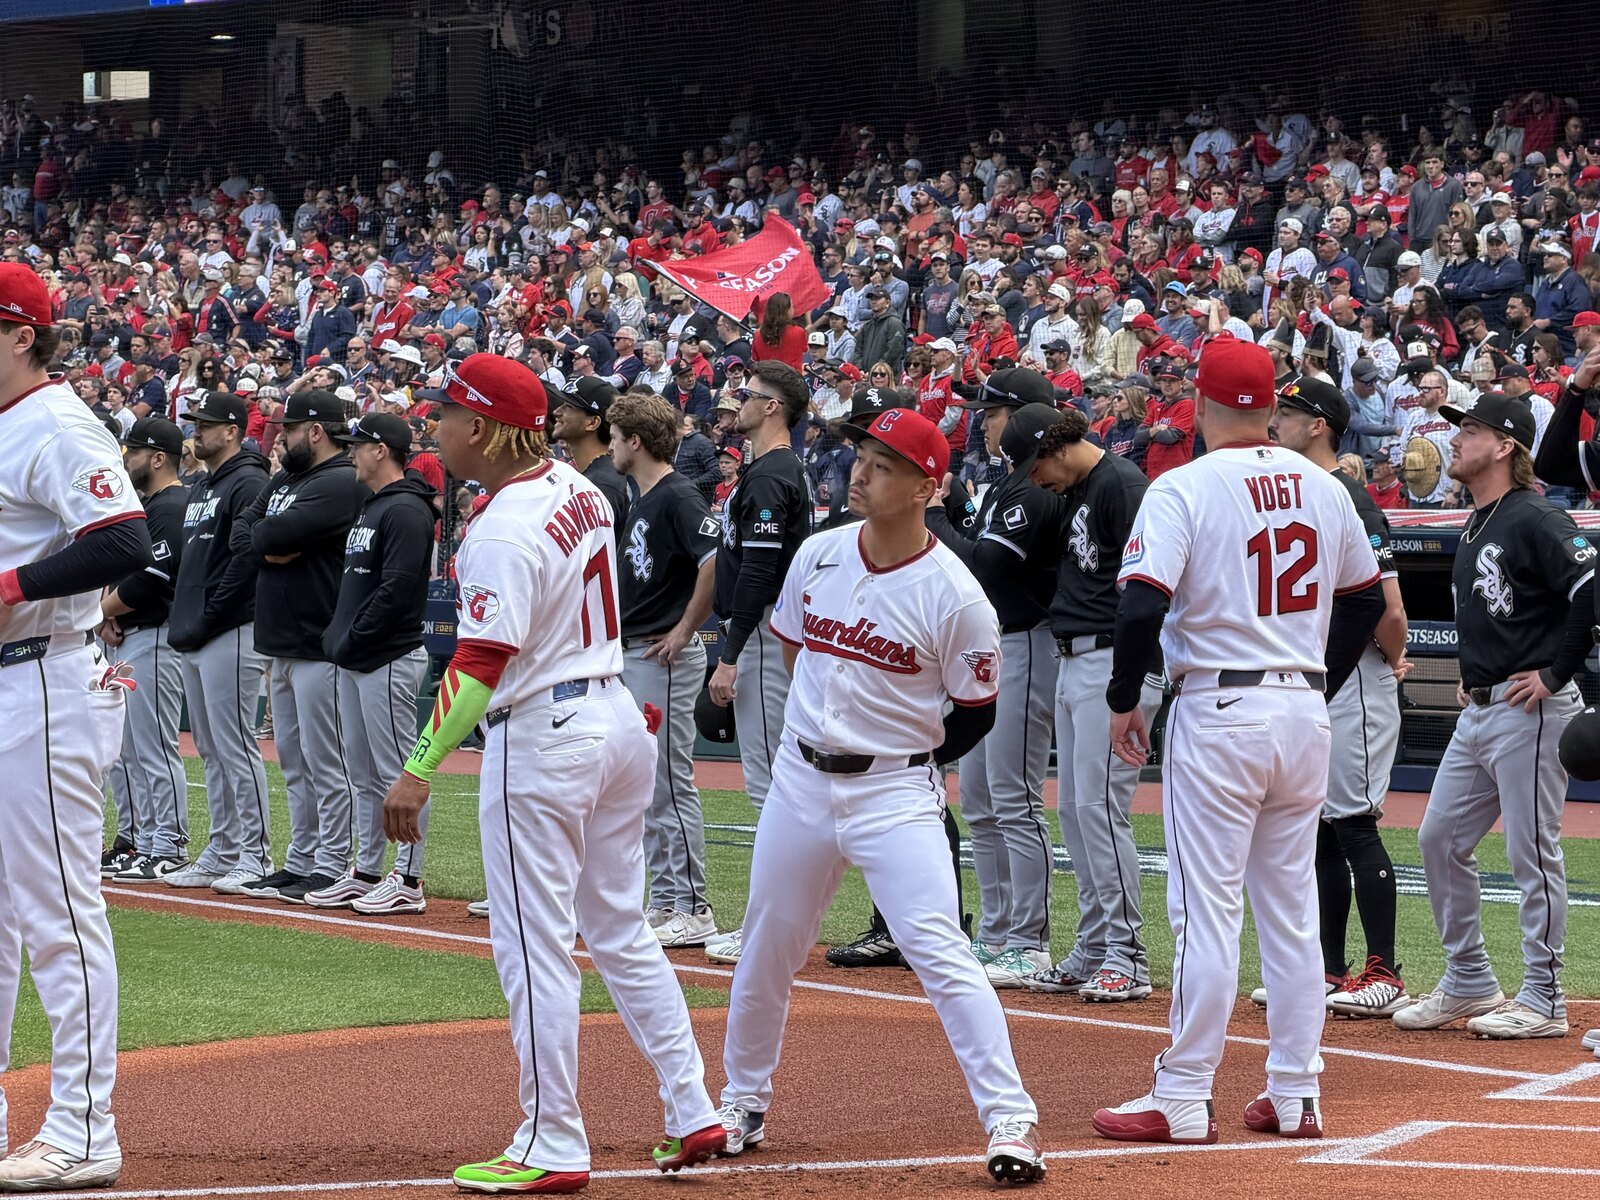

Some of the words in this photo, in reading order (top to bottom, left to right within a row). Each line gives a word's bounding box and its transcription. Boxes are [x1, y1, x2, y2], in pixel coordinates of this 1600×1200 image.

[1245, 473, 1302, 513] VOGT
[754, 523, 779, 534] CME
[1247, 521, 1319, 617] 12
[1472, 542, 1514, 618] Sox
[435, 624, 454, 632] 2026
[700, 633, 718, 642] 026
[803, 592, 917, 667] uardians
[1304, 1116, 1315, 1125] 23
